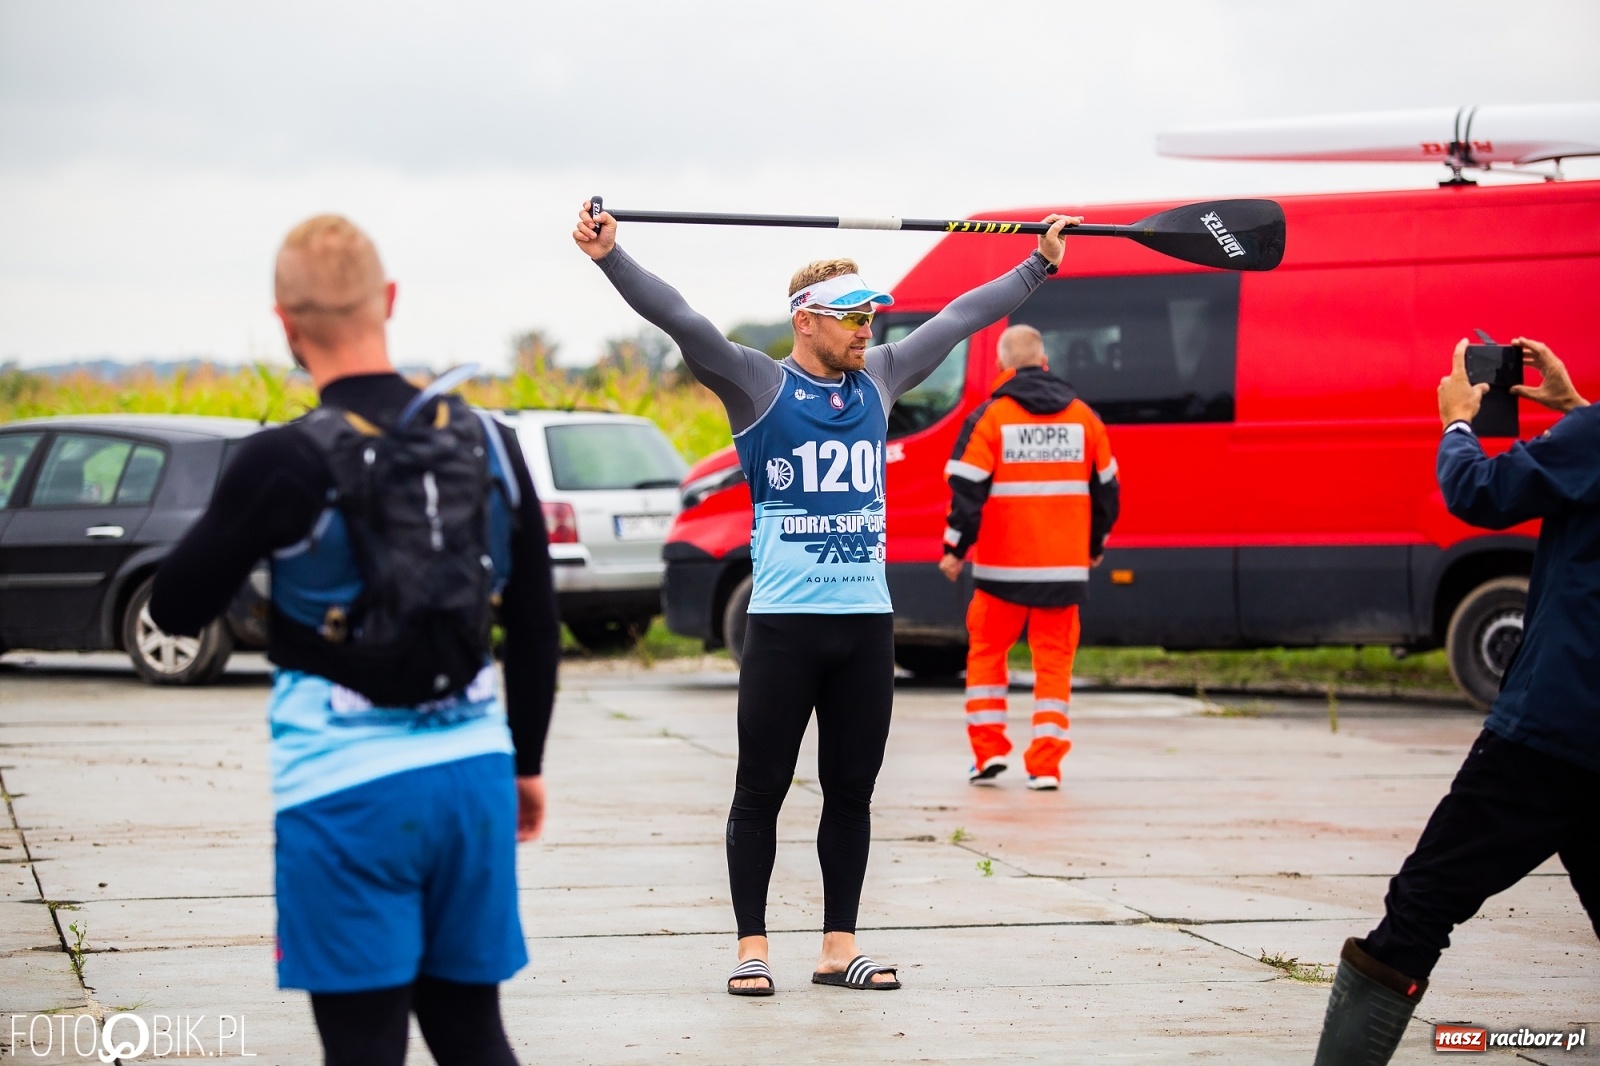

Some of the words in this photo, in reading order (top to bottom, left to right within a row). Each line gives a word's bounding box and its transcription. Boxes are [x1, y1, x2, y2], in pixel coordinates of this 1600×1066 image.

[1018, 427, 1069, 445] WOPR
[792, 440, 875, 493] 120
[783, 515, 831, 534] ODRA
[836, 515, 865, 533] SUP
